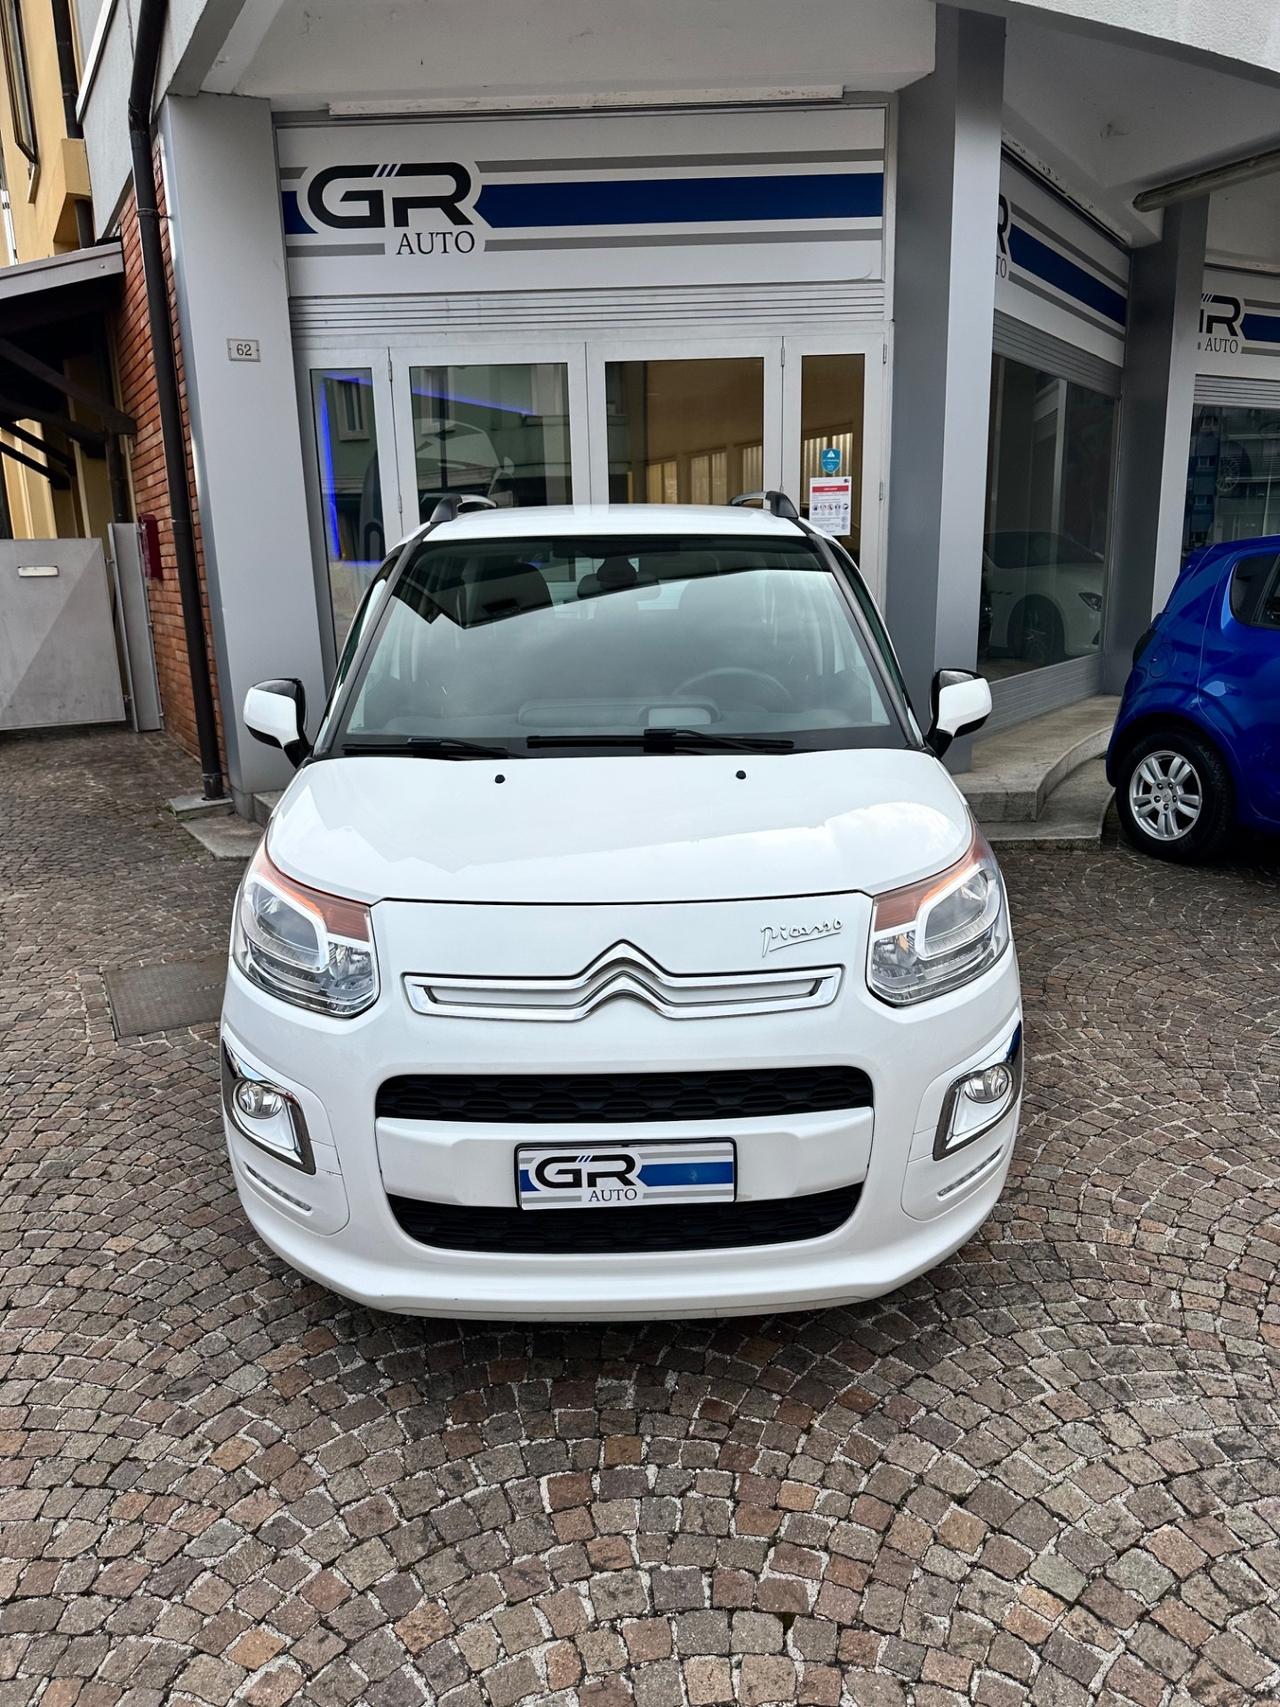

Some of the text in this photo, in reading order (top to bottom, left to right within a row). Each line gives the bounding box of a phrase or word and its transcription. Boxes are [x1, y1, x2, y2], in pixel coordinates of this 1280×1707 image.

[307, 162, 474, 229] GR
[395, 231, 475, 255] AUTO
[236, 343, 252, 356] 62
[1205, 337, 1239, 354] AUTO
[535, 1154, 636, 1189] GR
[588, 1188, 637, 1202] AUTO
